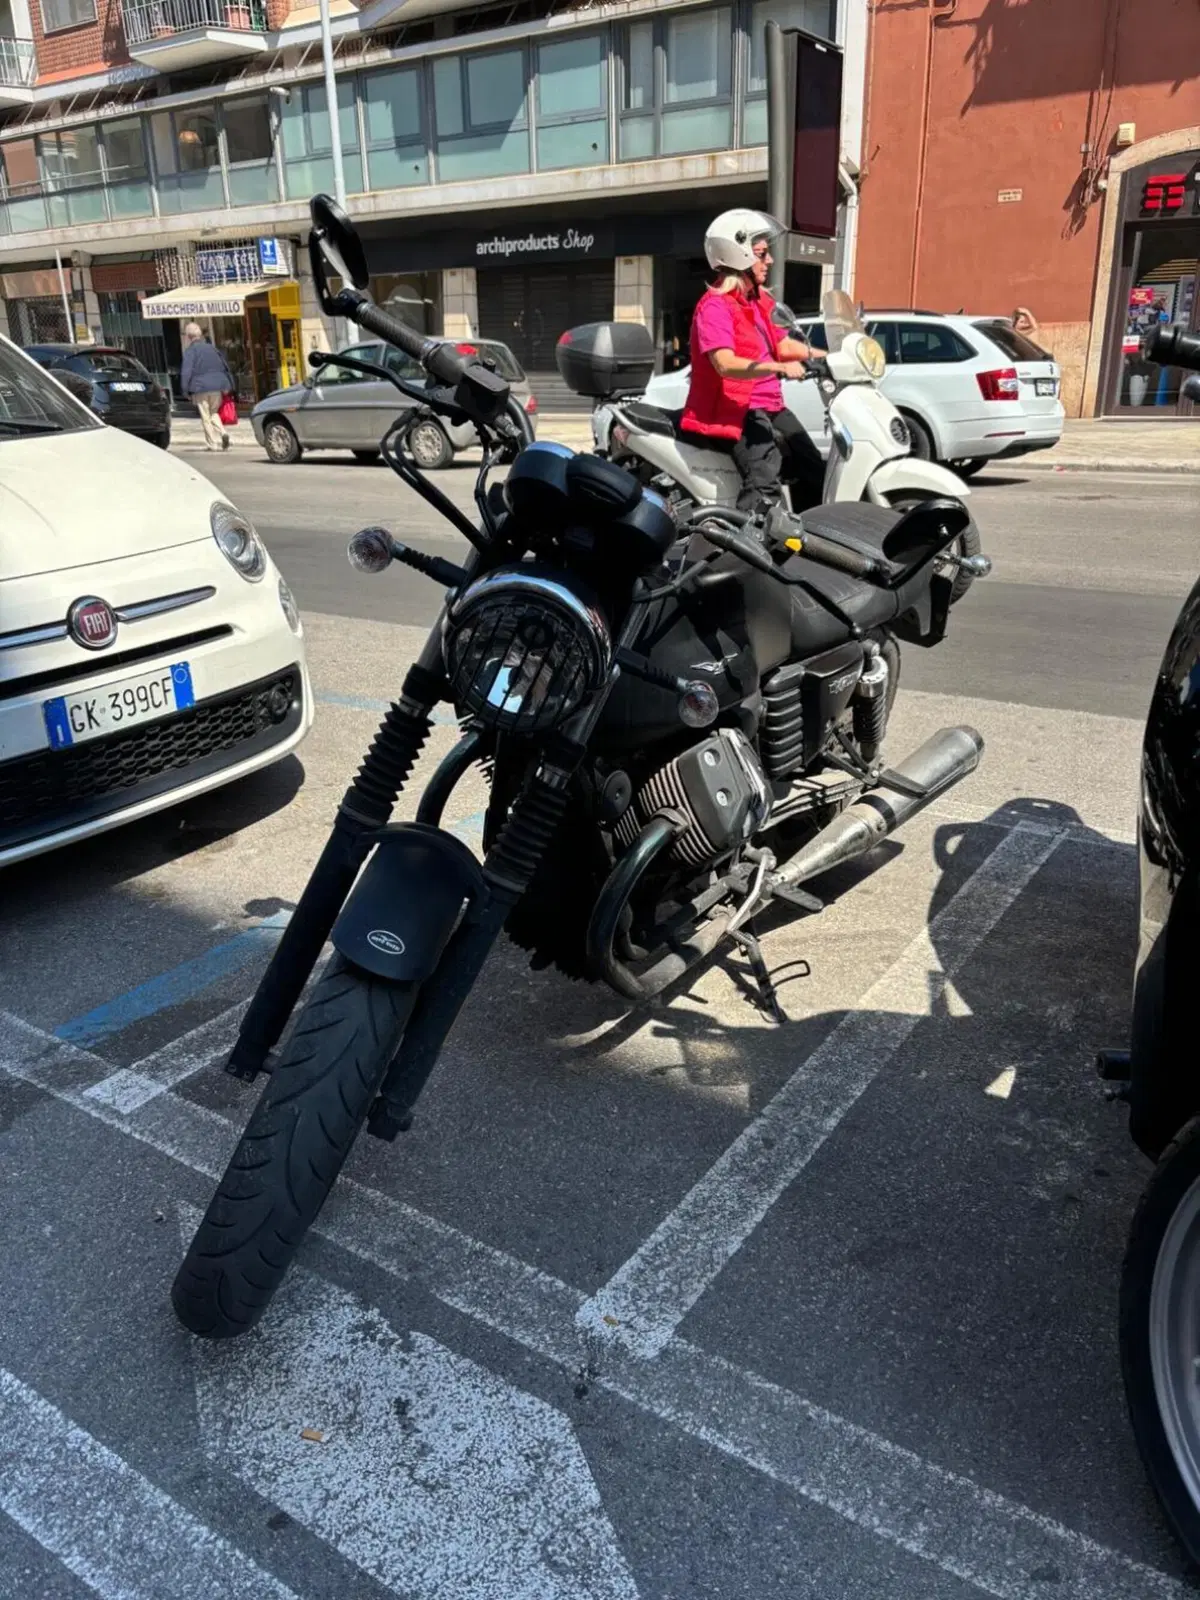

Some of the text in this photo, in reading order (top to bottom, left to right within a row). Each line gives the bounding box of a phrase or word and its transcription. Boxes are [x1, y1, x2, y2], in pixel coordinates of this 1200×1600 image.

[476, 228, 595, 257] archiproducts Shop
[198, 250, 258, 271] TABACCH
[146, 301, 241, 317] TABACCHERIA MILILLO
[83, 611, 108, 635] FIAT
